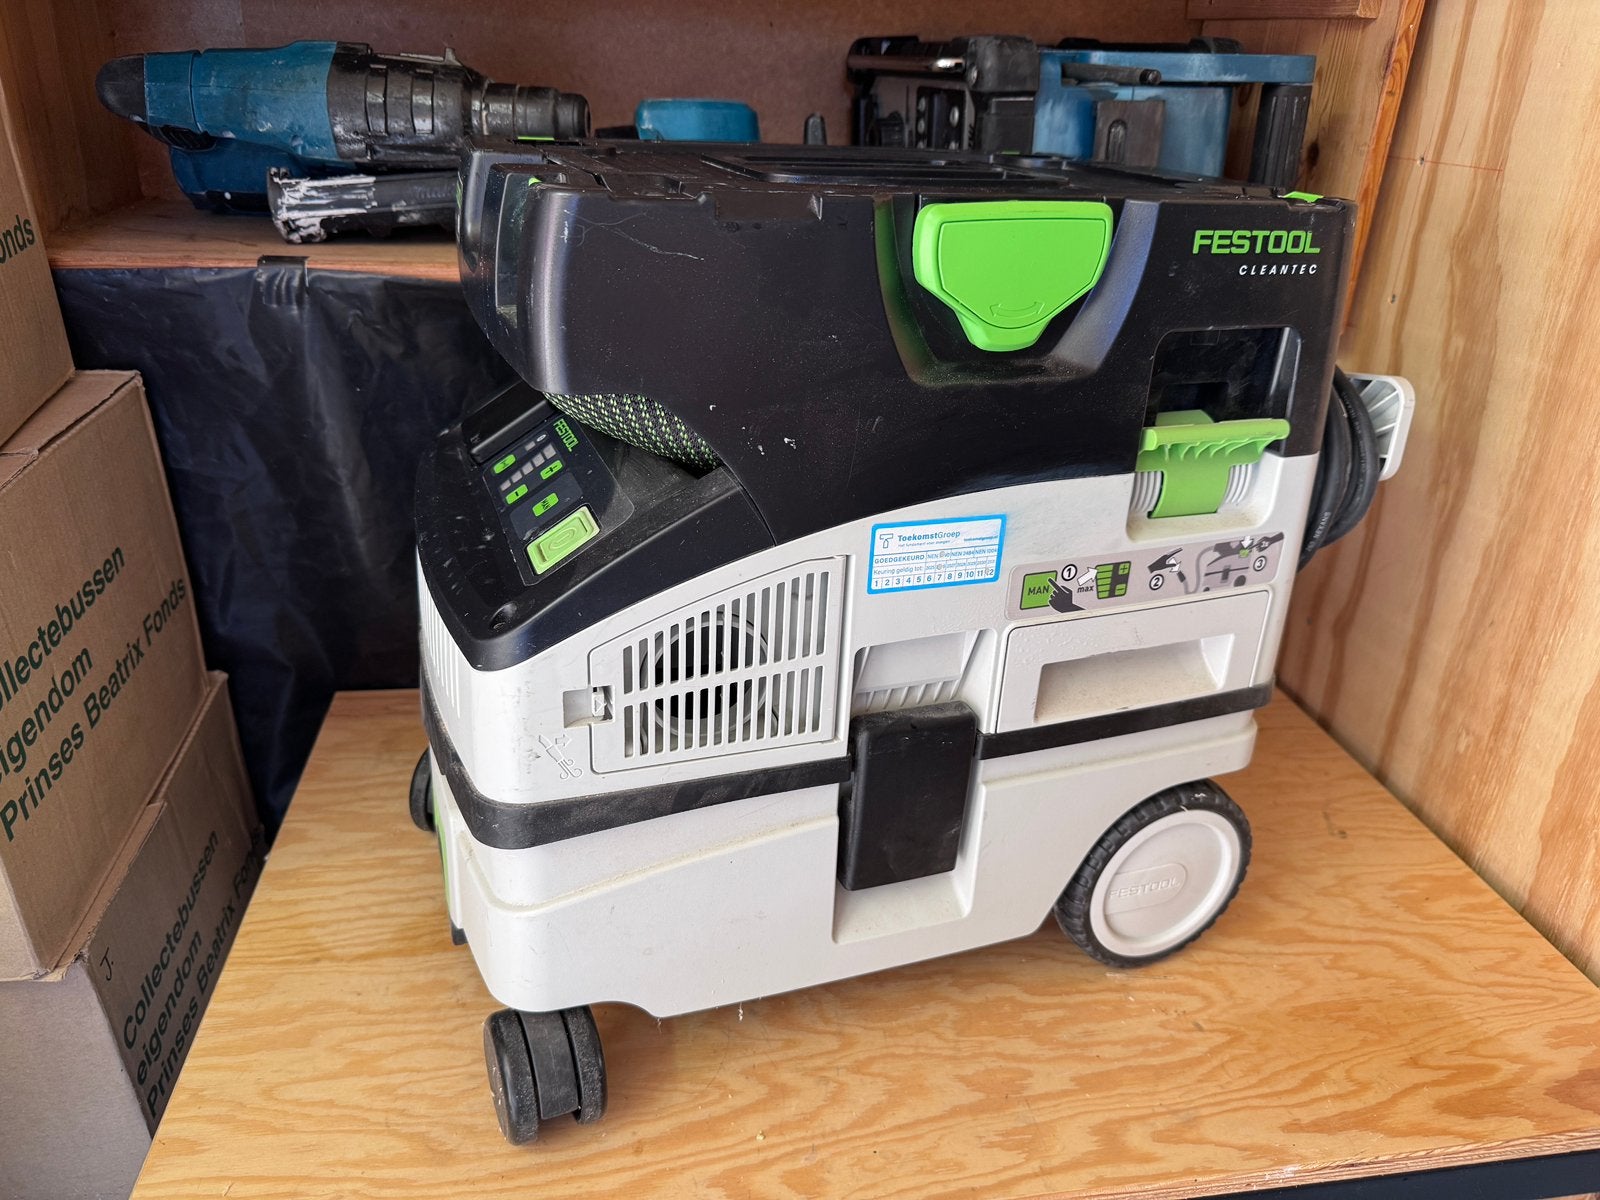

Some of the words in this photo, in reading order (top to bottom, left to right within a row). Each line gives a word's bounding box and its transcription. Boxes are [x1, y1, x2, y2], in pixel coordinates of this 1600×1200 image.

[1192, 230, 1321, 254] FESTOOL
[1239, 264, 1318, 276] CLEANTEC
[553, 418, 579, 452] FESTOOL
[897, 531, 961, 543] ToekomstGroep
[874, 554, 925, 564] GOEDGEKEURD
[874, 567, 896, 576] Keuring
[896, 566, 914, 574] geldig
[1027, 584, 1050, 596] MAN
[1076, 585, 1095, 594] max
[0, 547, 125, 712] llectebussen
[0, 722, 84, 843] Prinses
[83, 638, 145, 729] Beatrix
[143, 578, 187, 646] Fonds
[0, 647, 93, 784] igendom
[1108, 876, 1181, 899] FESTOOL
[123, 830, 219, 1050] Collectebussen
[136, 931, 202, 1086] eigendom
[146, 996, 198, 1118] Prinses
[197, 899, 236, 994] Beatrix
